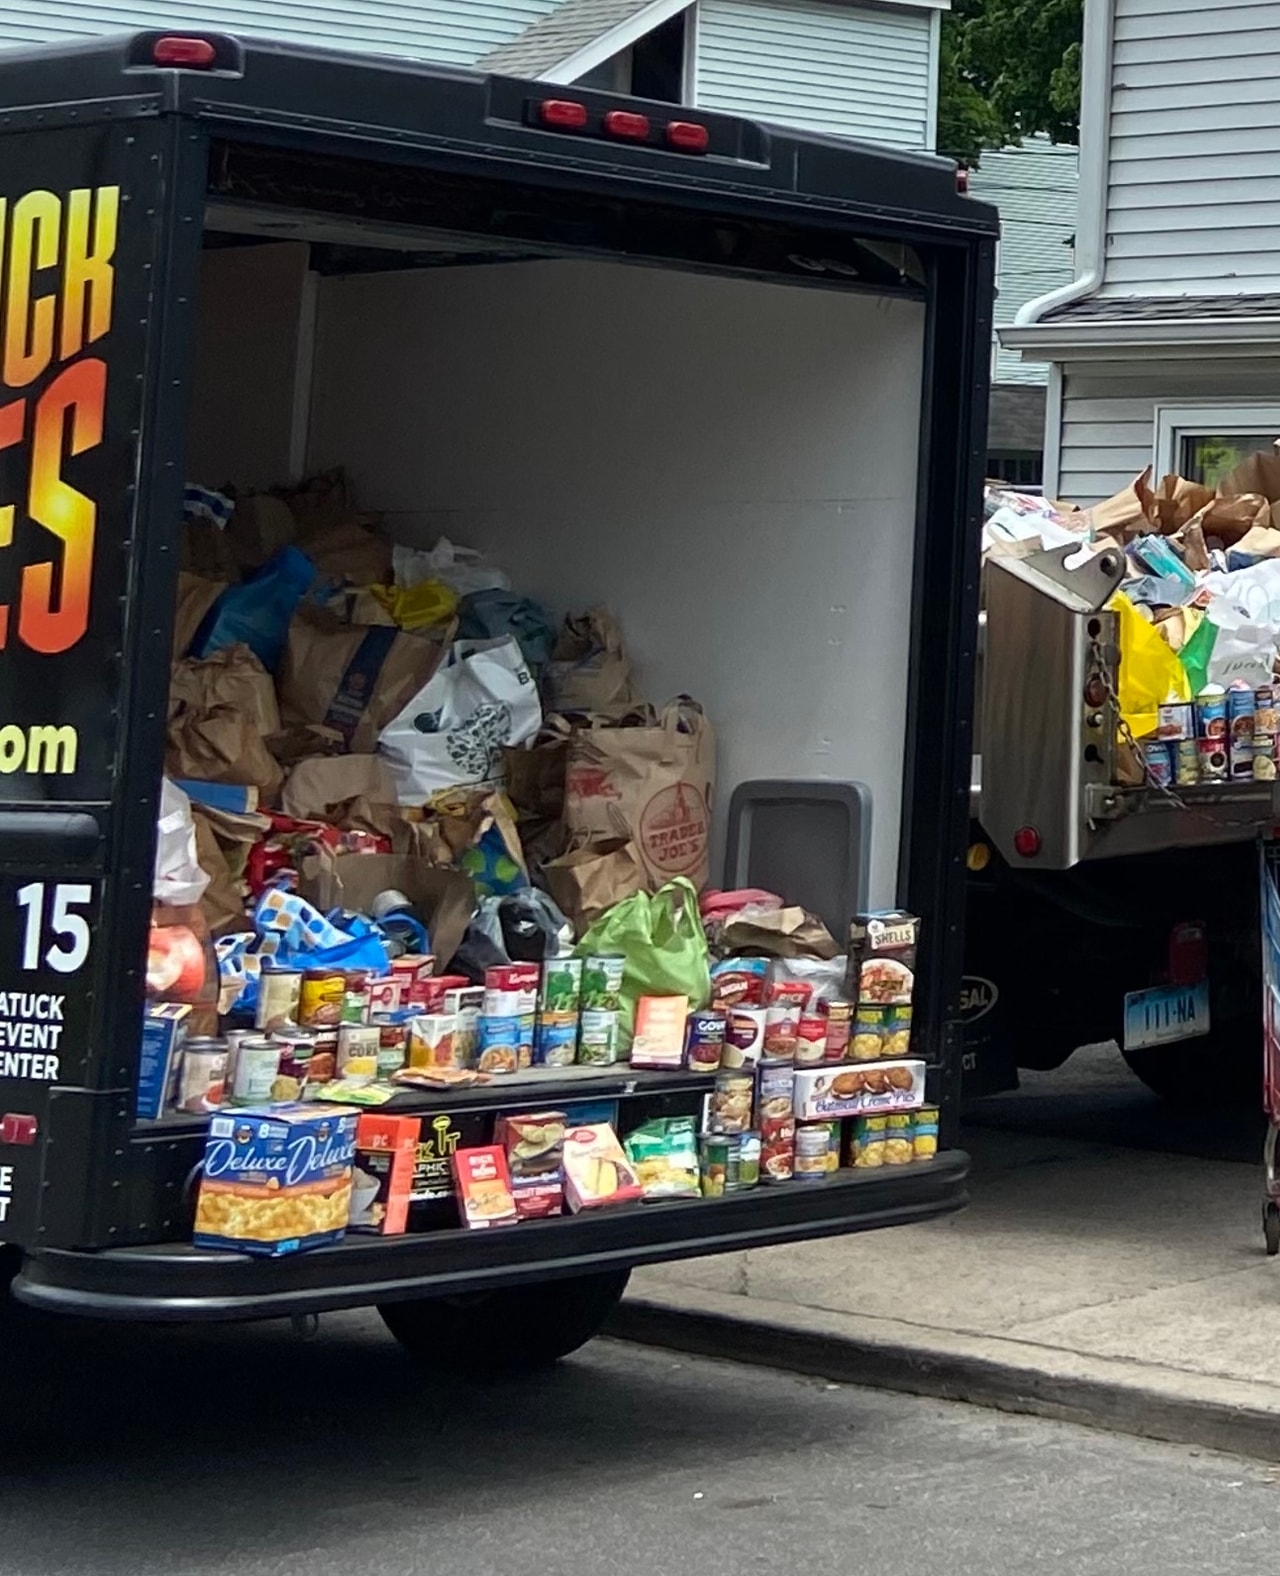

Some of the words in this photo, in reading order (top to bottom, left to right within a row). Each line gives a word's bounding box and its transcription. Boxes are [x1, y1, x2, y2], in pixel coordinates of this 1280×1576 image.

[0, 186, 120, 387] CK
[17, 882, 92, 974] 15
[874, 931, 913, 947] SHELLS
[698, 1019, 726, 1031] GOY
[0, 1052, 59, 1081] NTER
[205, 1138, 288, 1177] Deluxe
